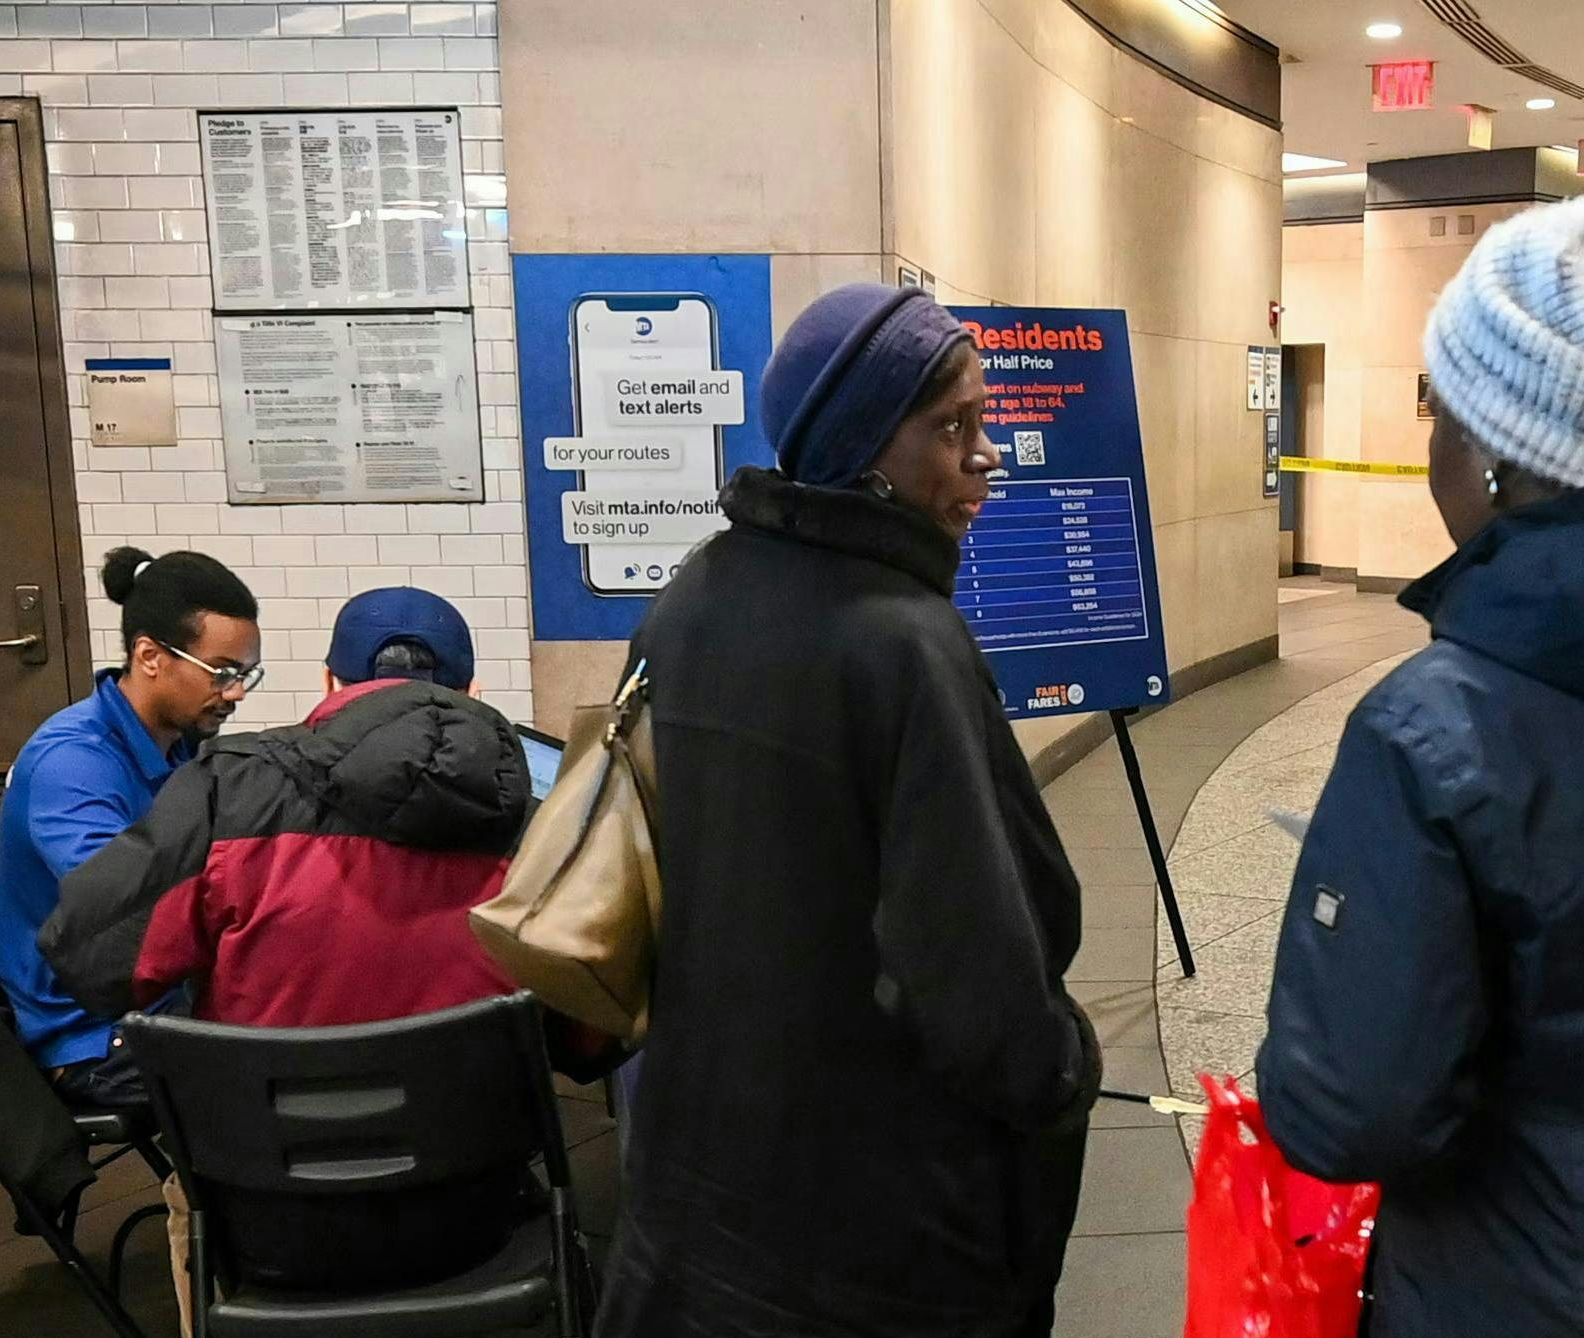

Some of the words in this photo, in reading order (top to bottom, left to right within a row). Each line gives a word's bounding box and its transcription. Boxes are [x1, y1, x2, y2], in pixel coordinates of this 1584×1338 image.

[1380, 65, 1427, 106] EXIT
[208, 119, 234, 128] Pledge
[237, 119, 245, 127] to
[209, 128, 252, 136] Customers
[962, 321, 1103, 351] Residents
[978, 358, 992, 370] or
[994, 355, 1019, 370] Half
[1020, 355, 1054, 370] Price
[91, 374, 117, 384] Pump
[119, 374, 146, 383] Room
[617, 379, 647, 395] Get
[650, 379, 696, 395] email
[699, 379, 730, 395] and
[619, 400, 652, 415] text
[654, 399, 703, 415] alerts
[95, 423, 104, 431] M
[107, 423, 117, 431] 17
[553, 445, 575, 460] for
[579, 448, 615, 464] your
[618, 445, 671, 460] routes
[571, 500, 606, 516] Visit
[608, 499, 724, 517] mta.info/notif
[573, 521, 589, 535] to
[592, 520, 626, 538] sign
[629, 523, 650, 538] up
[1035, 685, 1059, 698] FAIR
[1027, 696, 1061, 710] FARES
